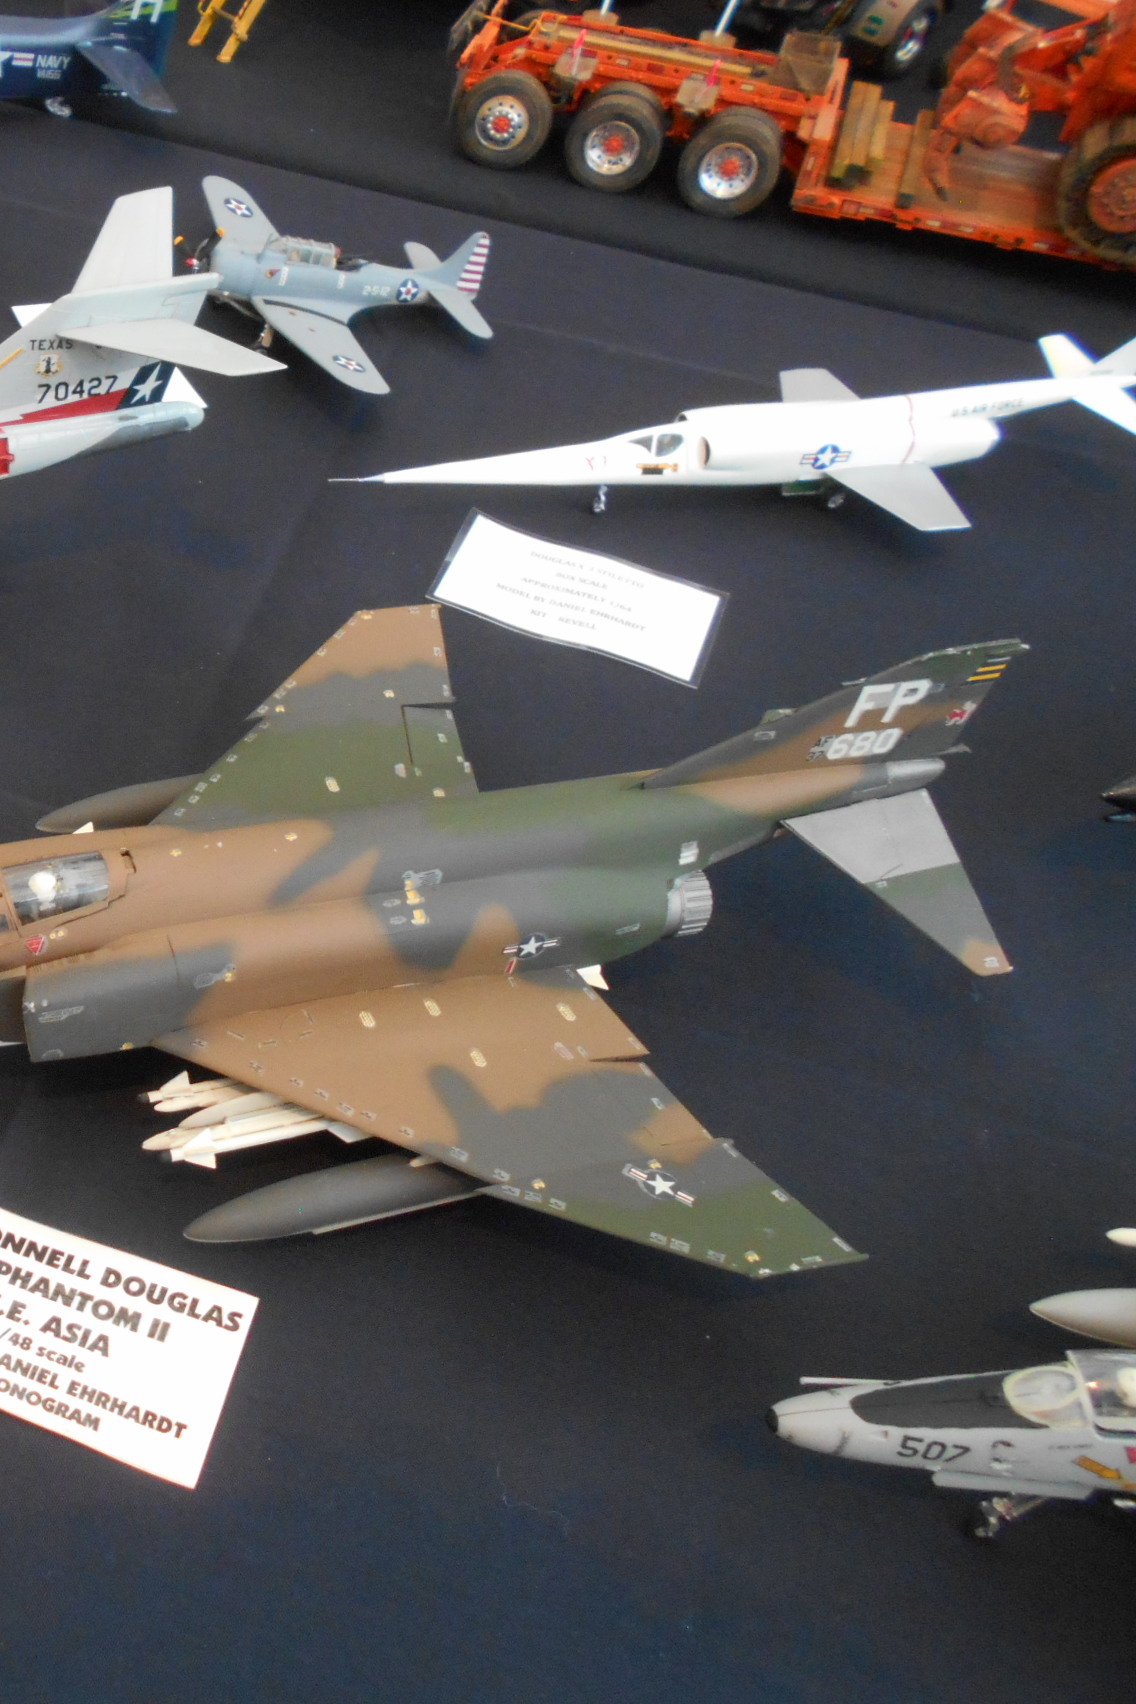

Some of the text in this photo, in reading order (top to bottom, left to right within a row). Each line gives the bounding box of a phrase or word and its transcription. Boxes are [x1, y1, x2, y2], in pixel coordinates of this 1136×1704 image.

[36, 54, 71, 69] NAVY
[30, 339, 73, 351] TEXAS
[37, 375, 119, 404] 70427
[496, 582, 531, 600] MODEL
[534, 594, 546, 603] BY
[548, 599, 587, 614] DANIEL
[530, 609, 598, 631] KIT REVELL
[844, 679, 933, 728] FP
[826, 728, 903, 760] 680
[100, 1267, 243, 1332] DOUGLAS
[39, 1316, 110, 1357] ASIA
[147, 1319, 171, 1343] II
[36, 1344, 85, 1373] scale
[66, 1381, 188, 1440] EHRHARDT
[896, 1435, 971, 1464] 507
